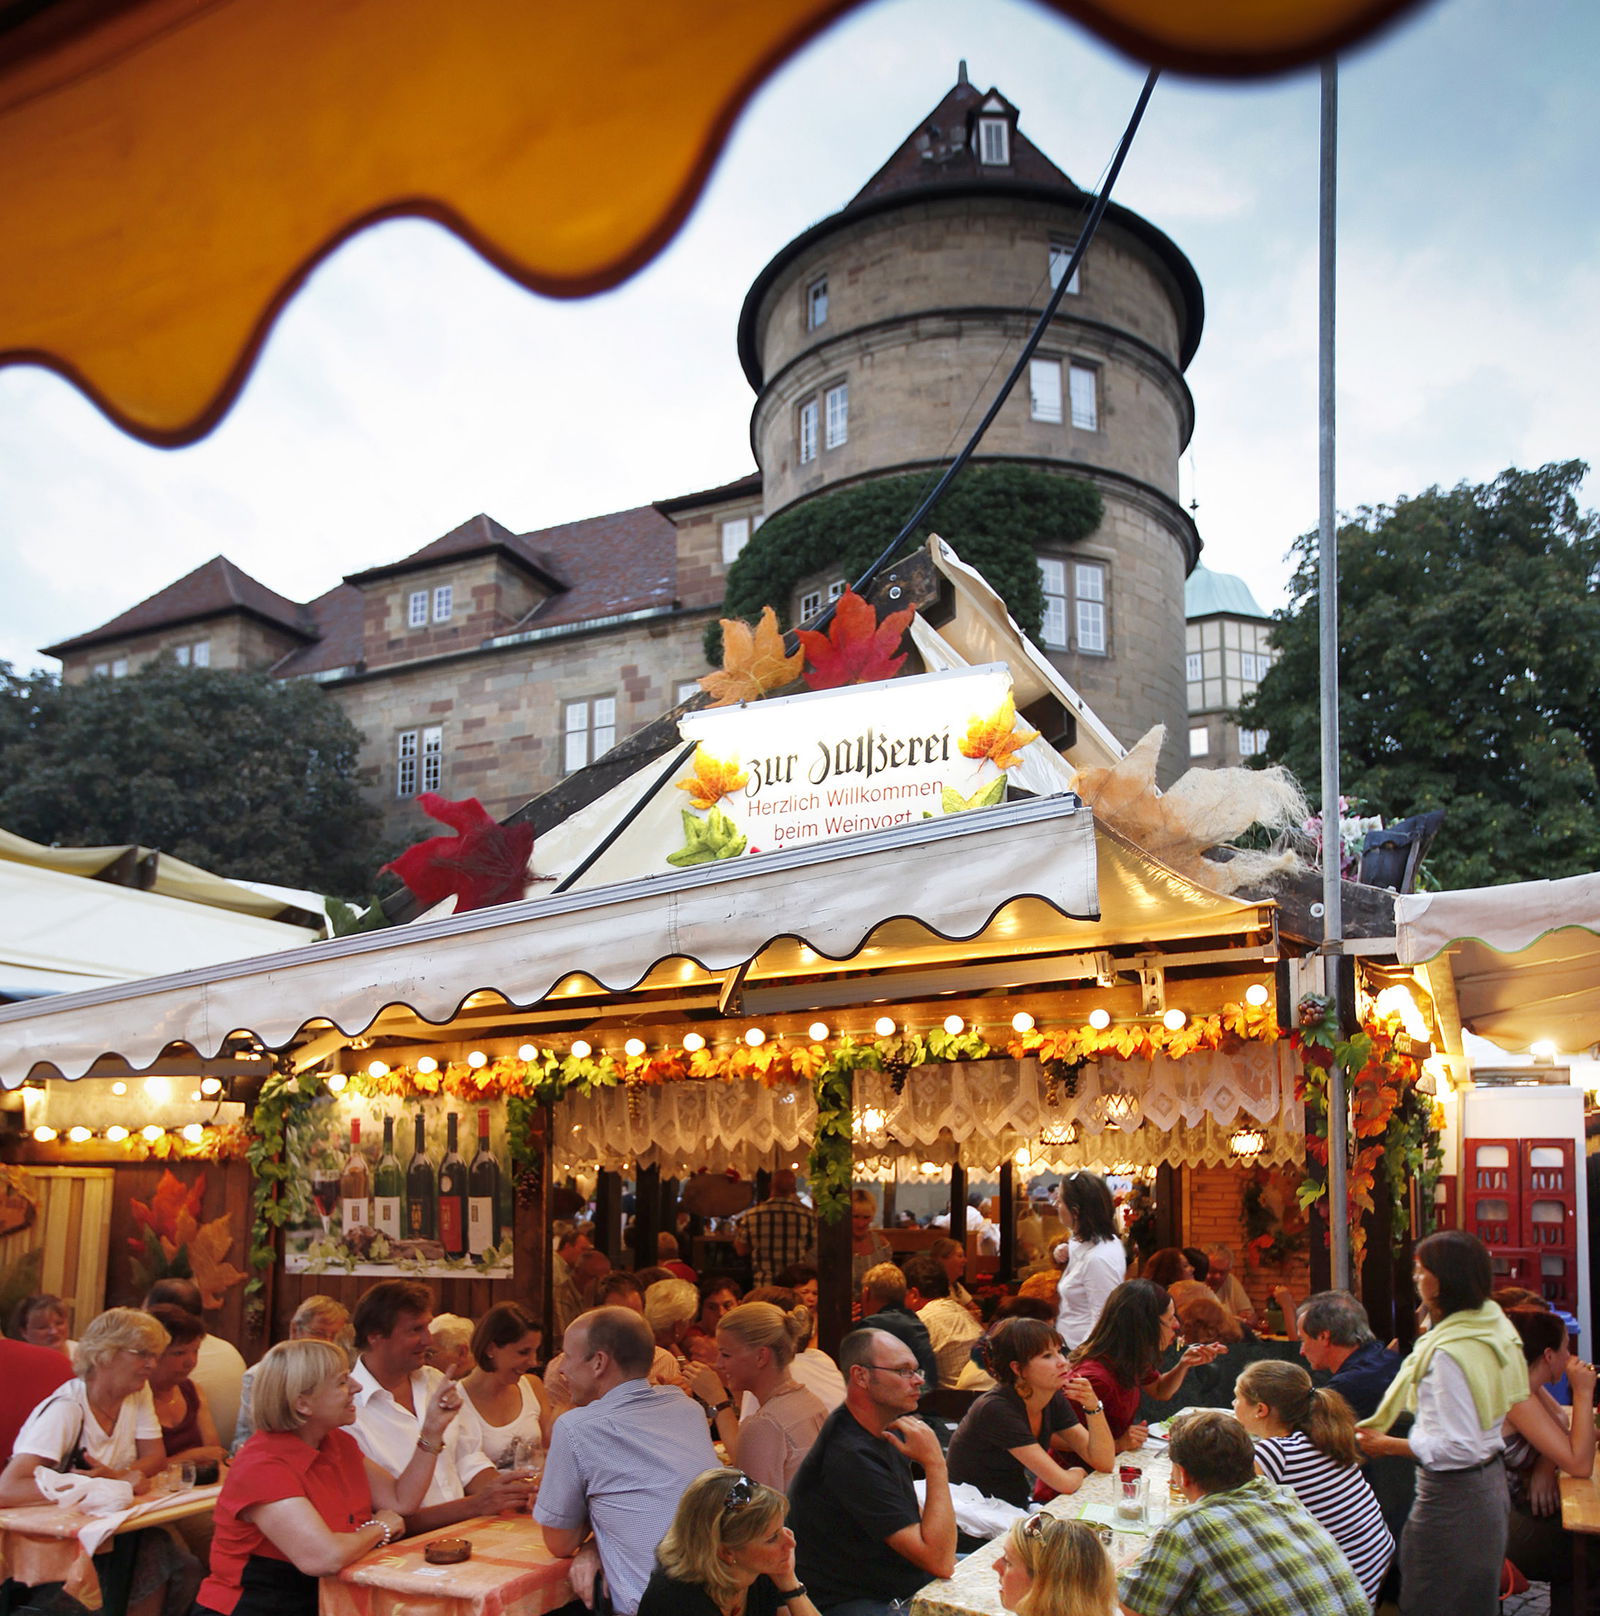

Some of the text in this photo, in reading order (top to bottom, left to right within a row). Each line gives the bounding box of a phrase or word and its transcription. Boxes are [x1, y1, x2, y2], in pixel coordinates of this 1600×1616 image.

[745, 754, 798, 798] zur
[748, 780, 943, 817] Herzlich Willkommen
[774, 821, 818, 841] beim
